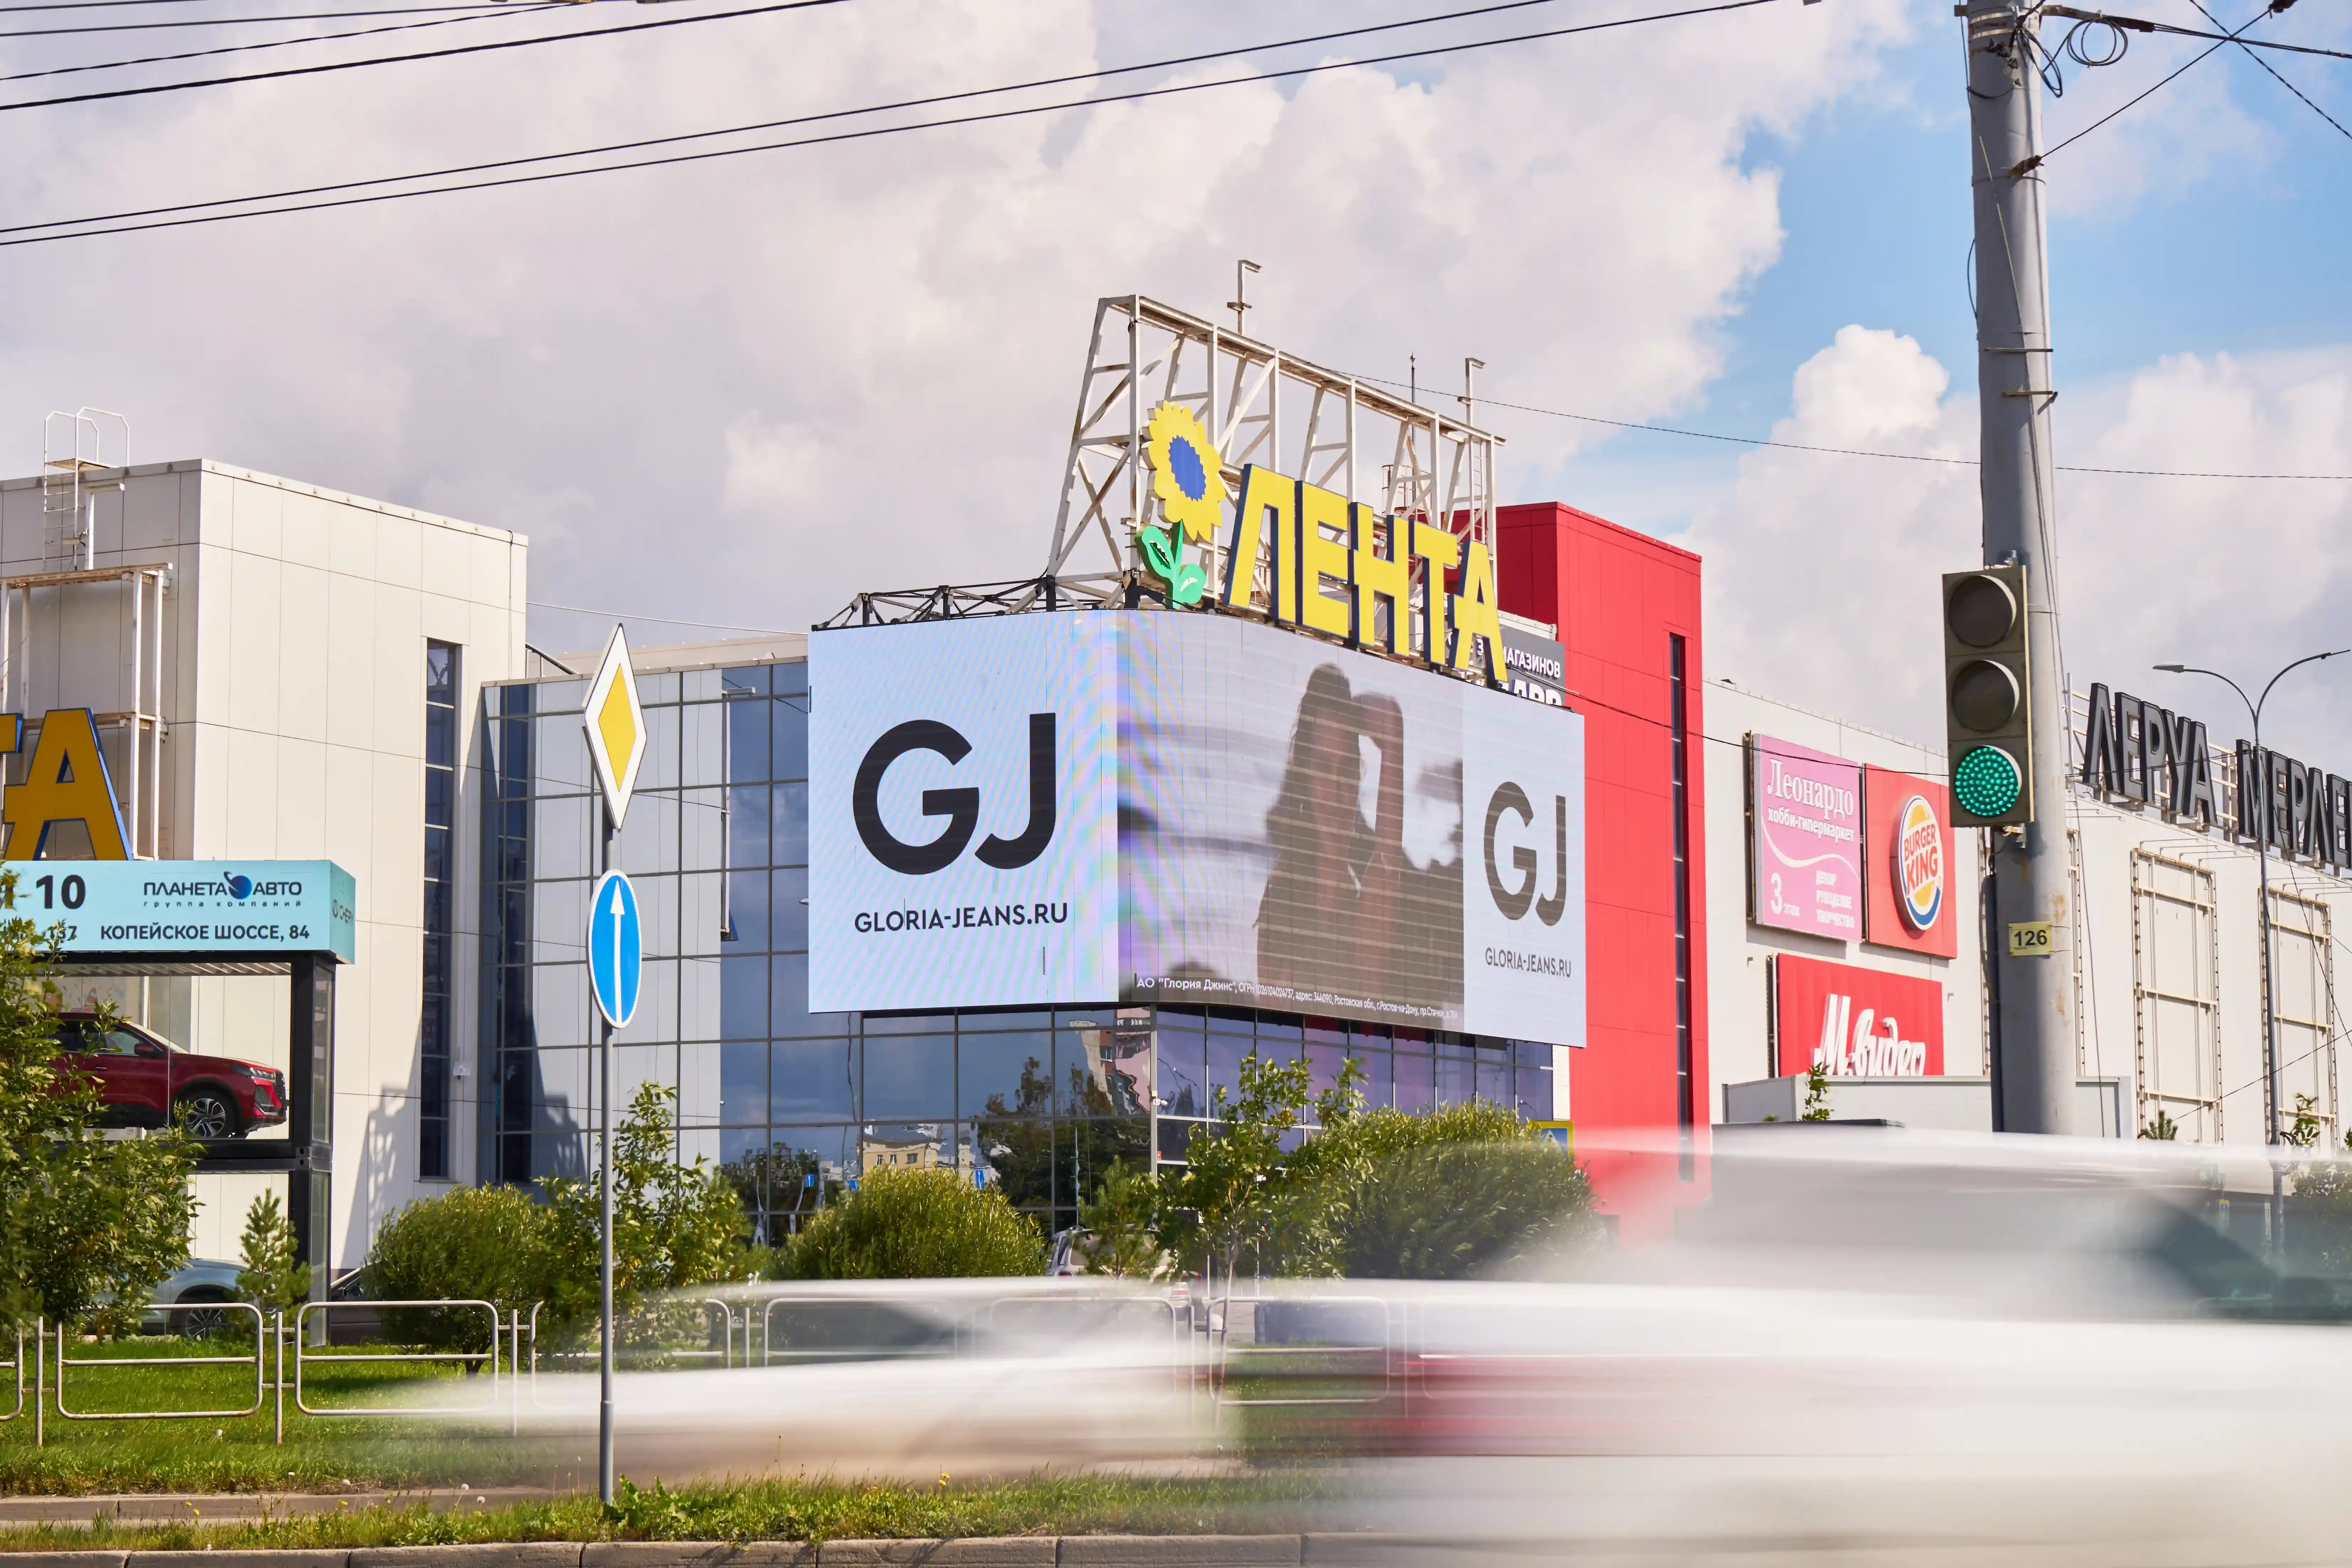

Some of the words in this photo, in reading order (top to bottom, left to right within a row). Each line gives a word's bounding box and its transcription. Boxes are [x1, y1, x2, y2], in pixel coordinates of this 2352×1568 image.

[1223, 464, 1507, 682] ЛЕНТА
[0, 707, 134, 861] А
[853, 713, 1056, 875] GJ
[1767, 758, 1854, 822] Леонардо
[2083, 682, 2218, 826] ЛЕРУА
[2236, 739, 2352, 869] МЕРЛЕ
[1767, 807, 1854, 843] хобби-гипермаркет
[1904, 824, 1936, 862] BURGER
[1484, 781, 1566, 926] GJ
[1906, 846, 1938, 896] KING
[36, 874, 85, 909] 10
[144, 882, 228, 896] ПЛАНЕТА
[253, 882, 302, 896] АВТО
[1770, 872, 1782, 914] 3
[101, 922, 209, 939] КОПЕЙСКОЕ
[215, 925, 284, 942] ШОССЕ,
[289, 925, 310, 939] 84
[855, 903, 1067, 933] GLORIA-JEANS.RU
[2014, 929, 2047, 946] 126
[1485, 947, 1571, 978] GLORIA-JEANS.RU
[1137, 978, 1155, 988] АО
[1158, 978, 1201, 991] "Глория
[1204, 979, 1237, 993] Джинс",
[1238, 982, 1255, 994] ОГРН
[1295, 991, 1312, 1002] адрес:
[1313, 992, 1333, 1005] 344090,
[1334, 994, 1363, 1007] Ростовская
